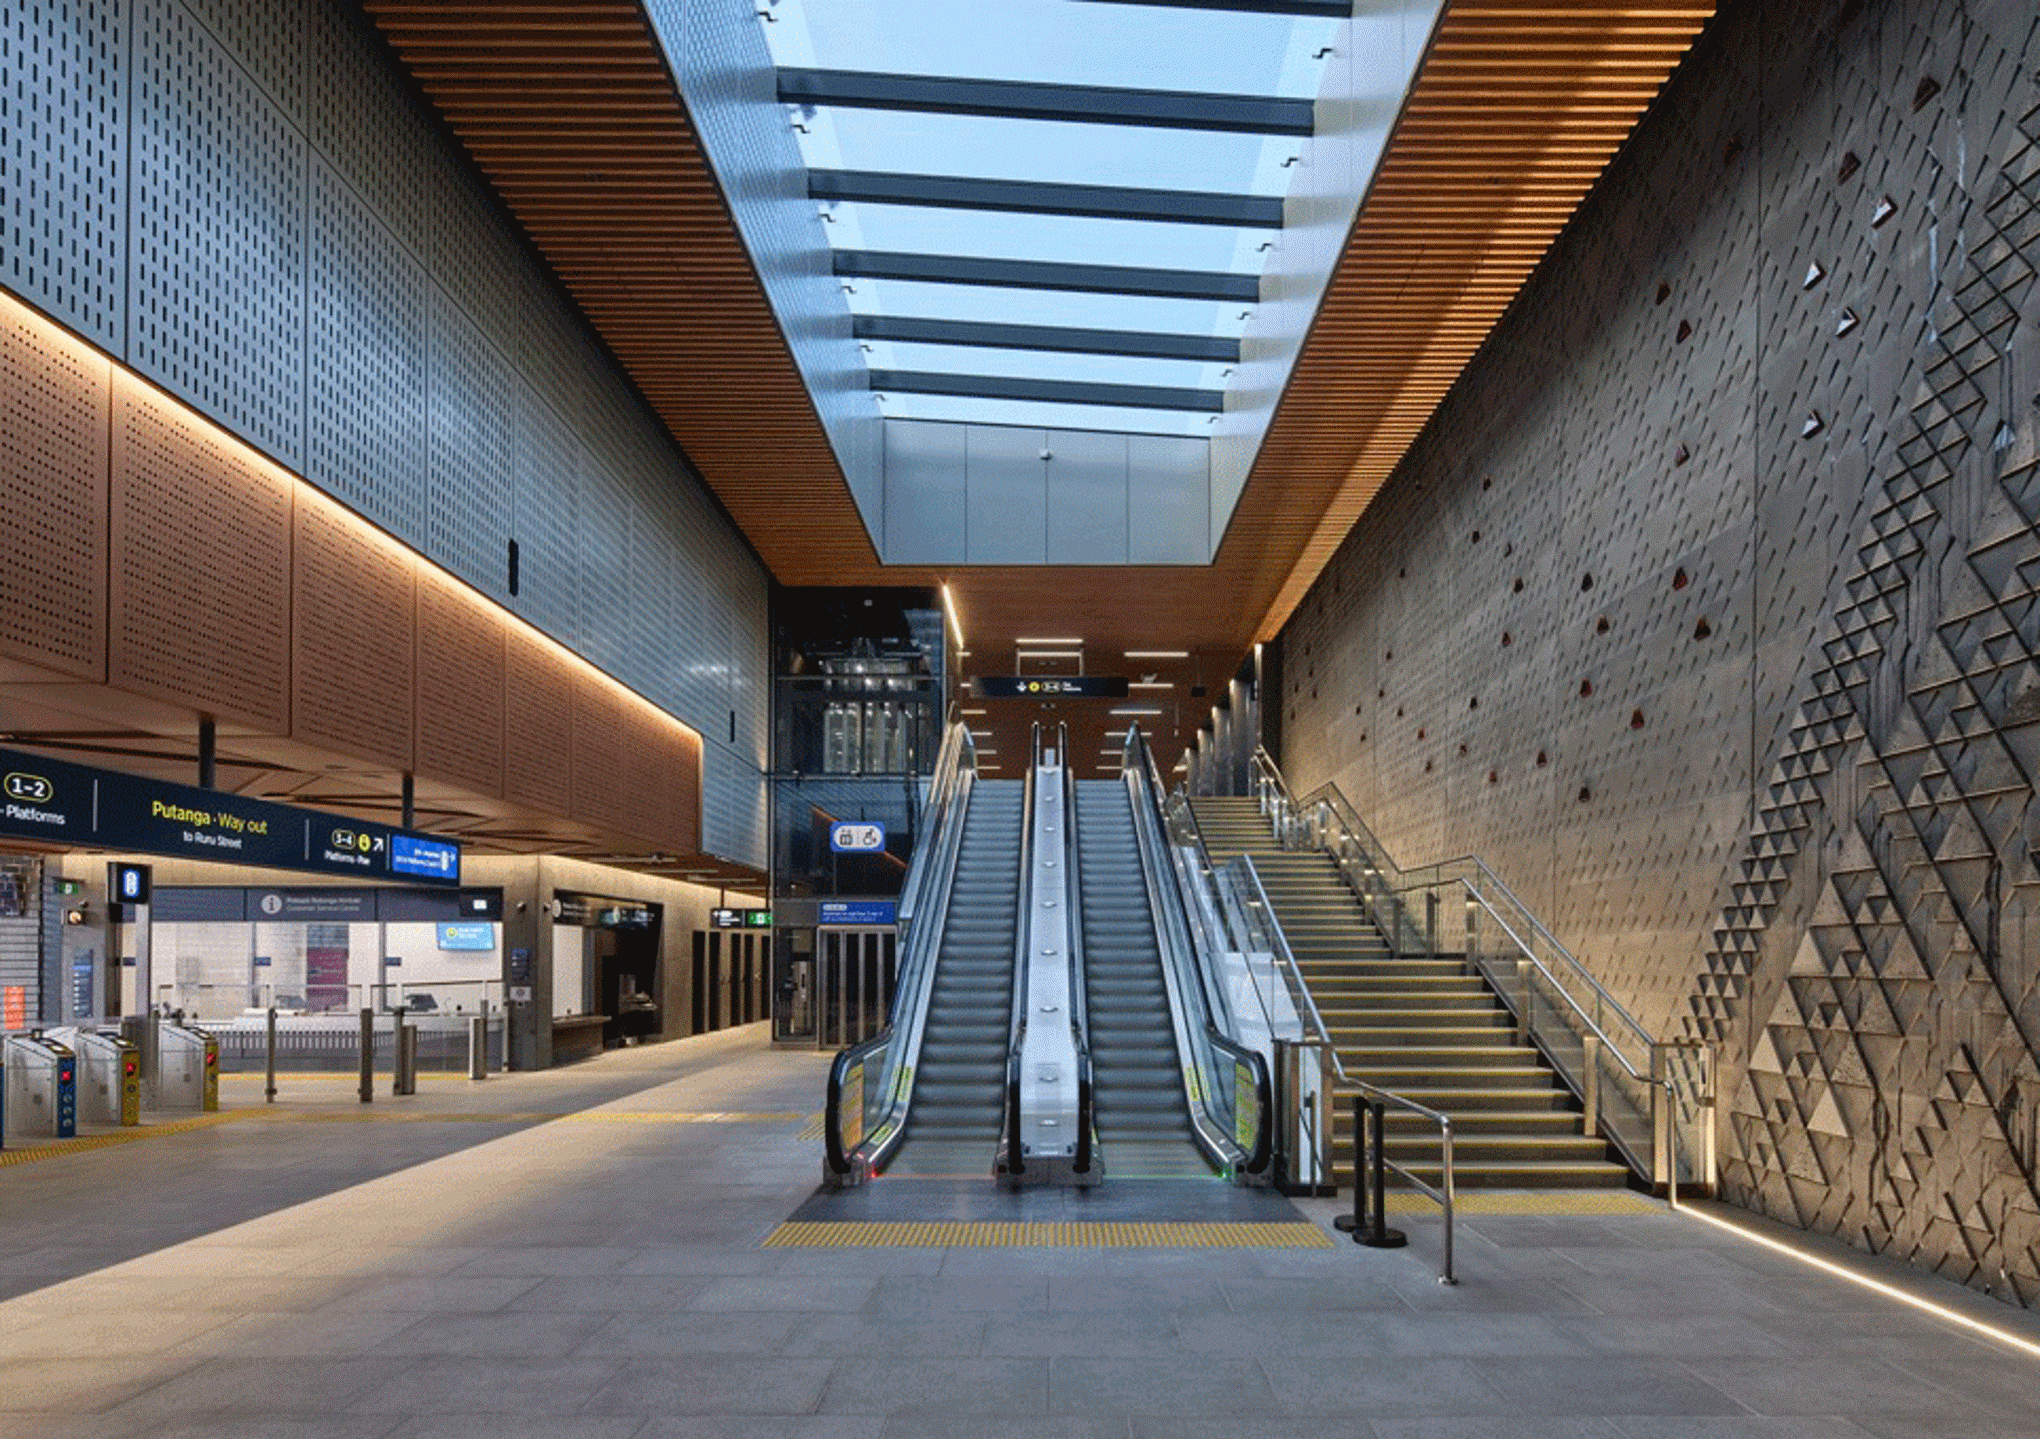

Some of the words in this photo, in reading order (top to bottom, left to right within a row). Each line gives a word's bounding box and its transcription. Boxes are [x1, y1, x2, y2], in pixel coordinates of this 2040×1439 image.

[12, 777, 46, 797] 1-2
[5, 803, 66, 825] Platforms
[152, 800, 211, 827] Putanga
[217, 811, 245, 833] Way
[247, 820, 267, 835] out
